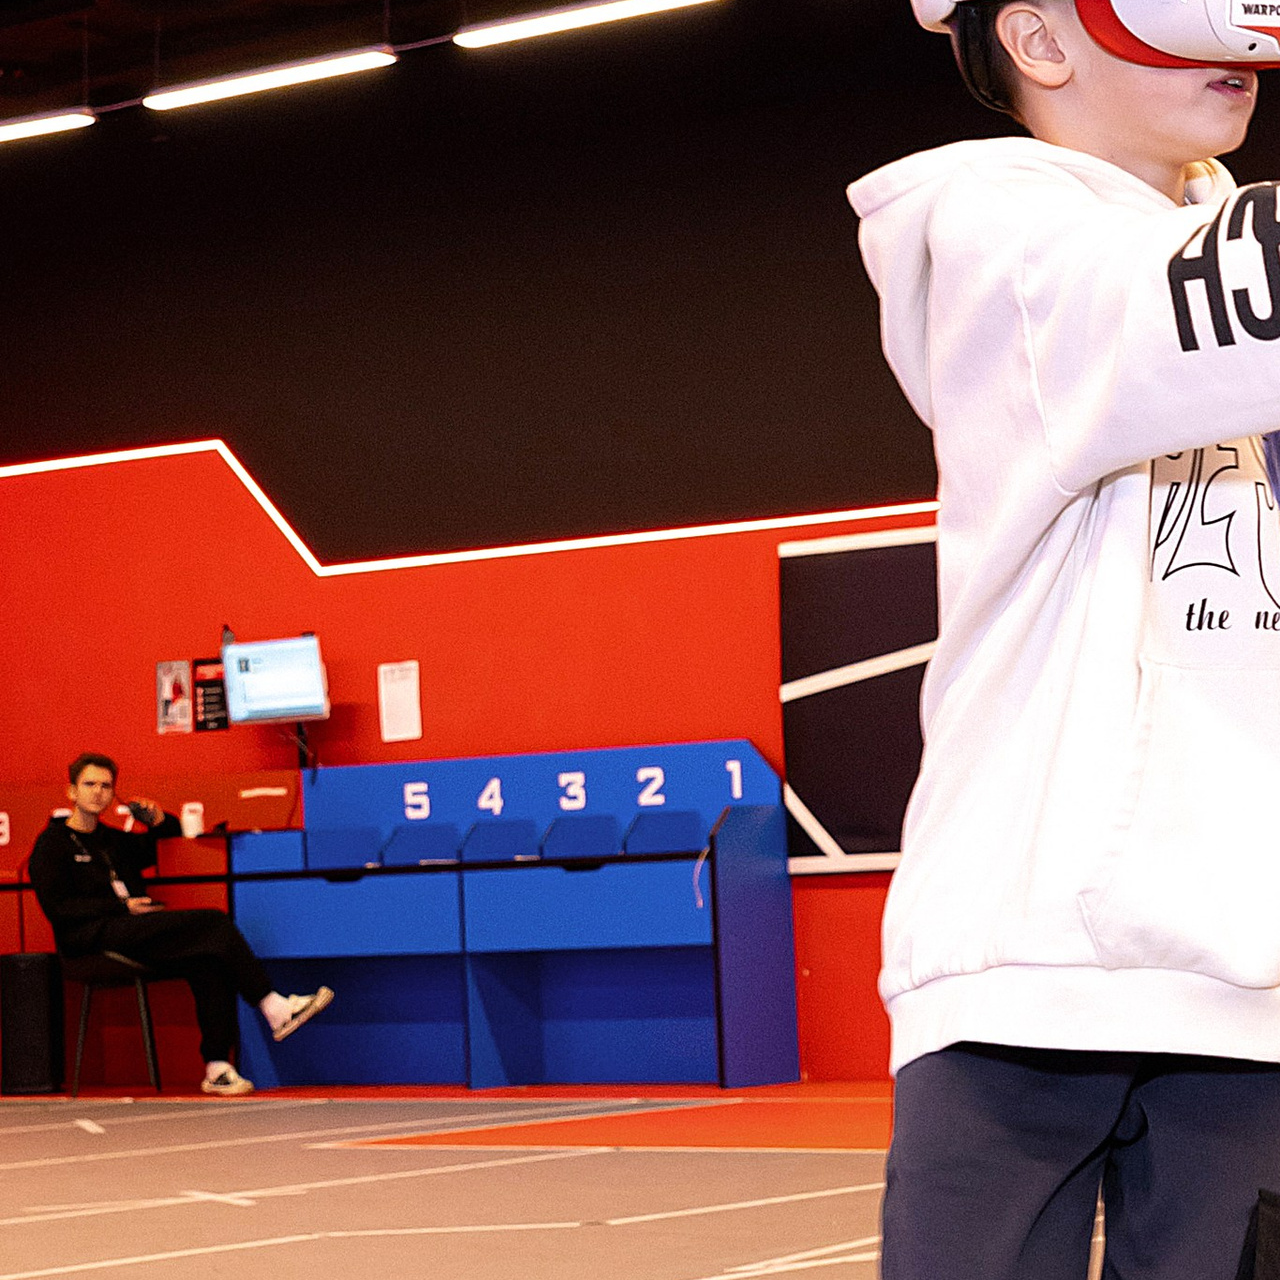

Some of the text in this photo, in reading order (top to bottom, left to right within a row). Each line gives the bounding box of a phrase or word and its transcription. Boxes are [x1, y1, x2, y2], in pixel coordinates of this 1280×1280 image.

[1185, 598, 1232, 631] the
[404, 760, 744, 819] 5 4 3 2 1
